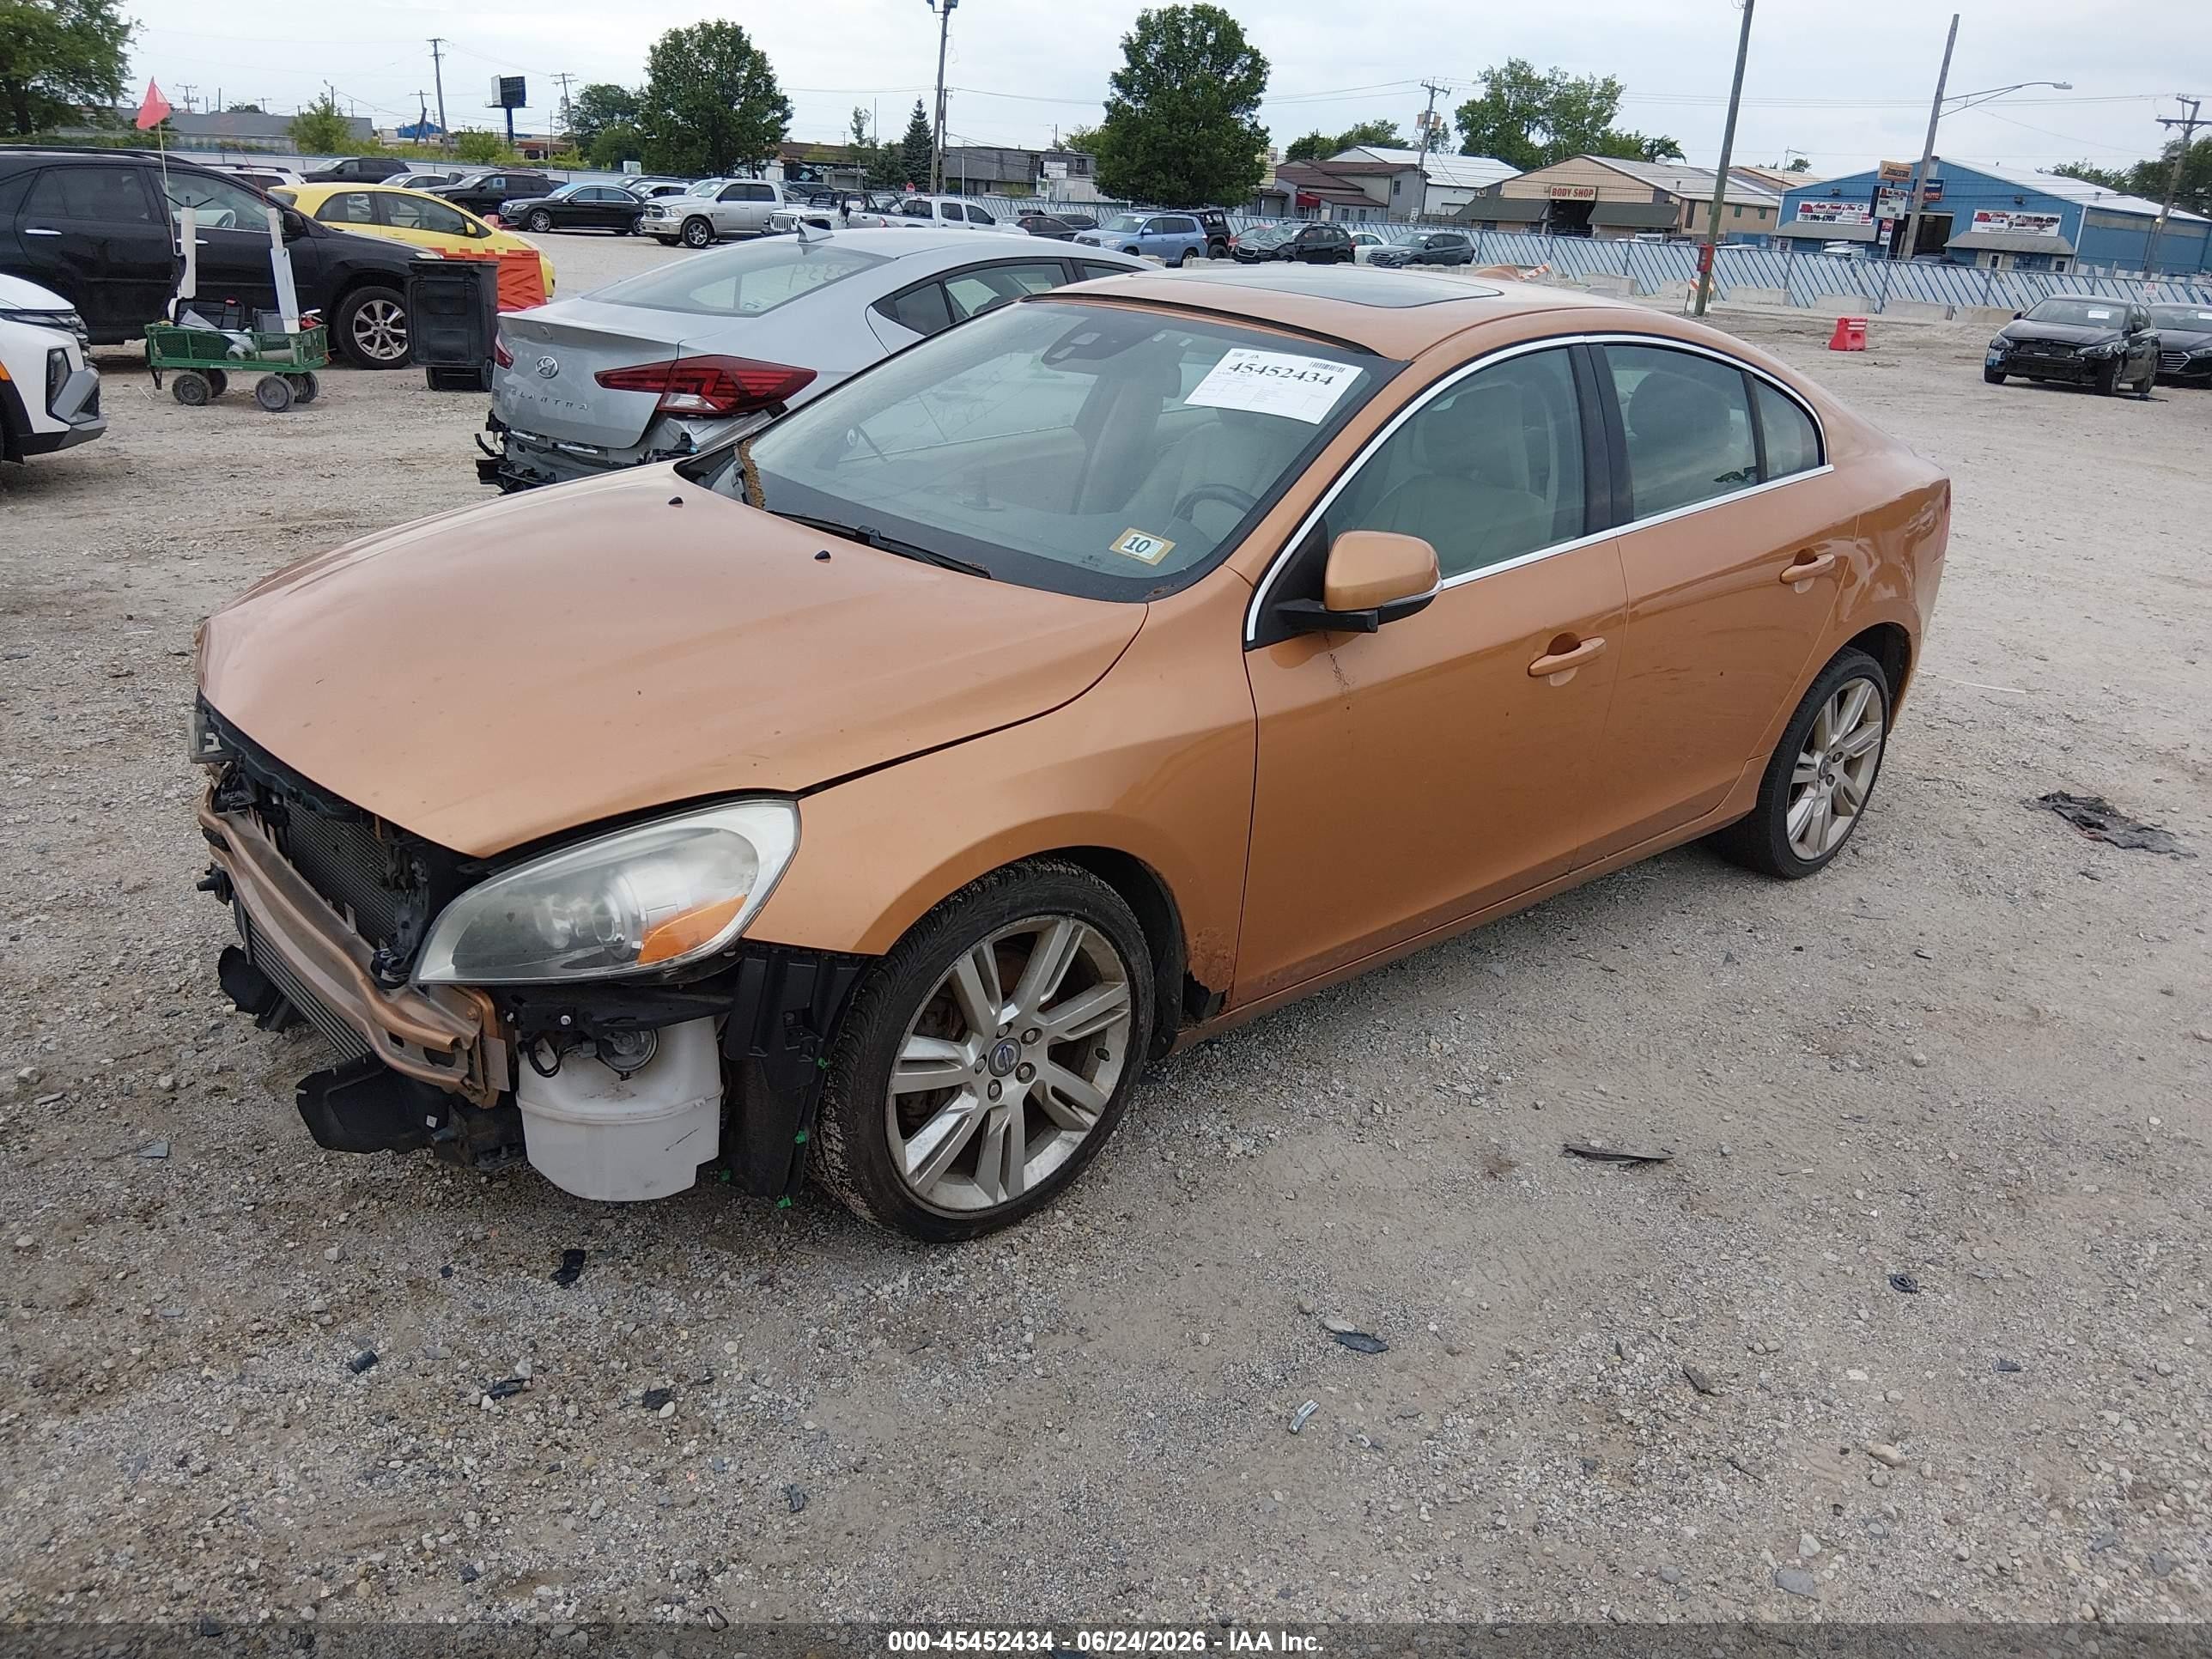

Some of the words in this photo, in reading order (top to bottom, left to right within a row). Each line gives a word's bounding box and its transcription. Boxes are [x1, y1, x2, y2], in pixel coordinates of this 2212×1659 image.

[1552, 187, 1571, 197] BODY
[1573, 188, 1594, 198] SHOP
[1228, 362, 1334, 386] 45452434
[1124, 537, 1152, 553] 10
